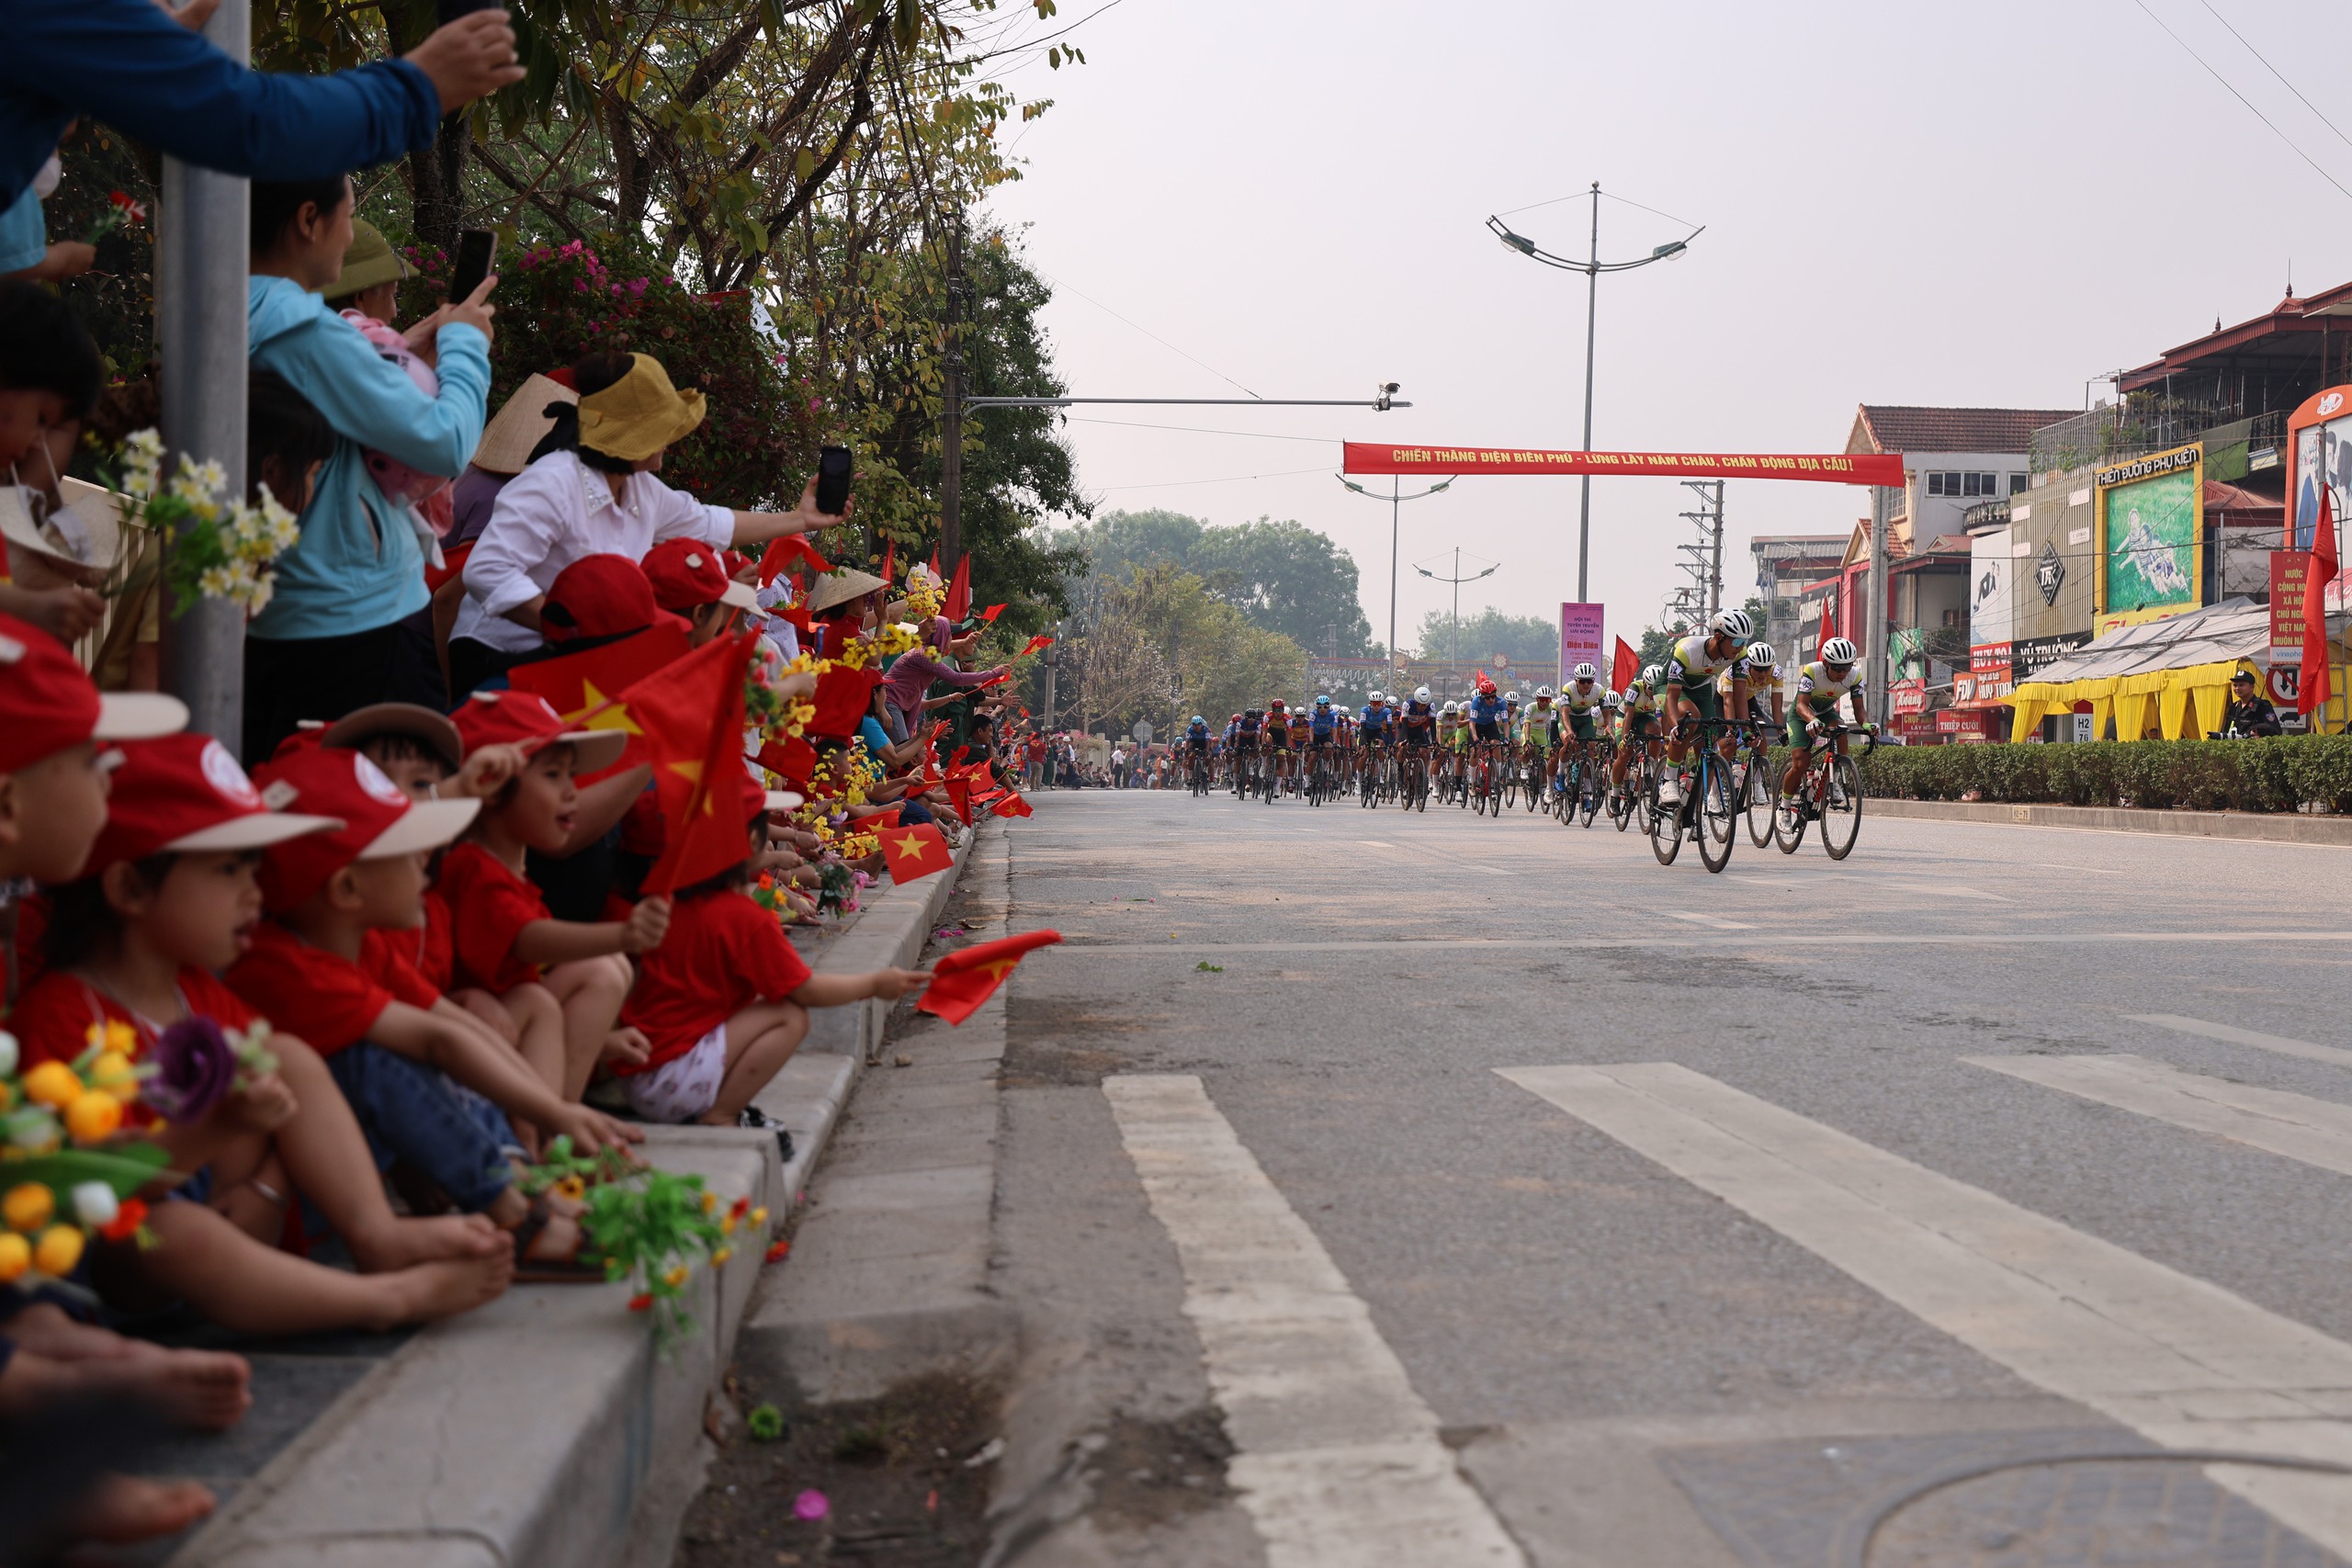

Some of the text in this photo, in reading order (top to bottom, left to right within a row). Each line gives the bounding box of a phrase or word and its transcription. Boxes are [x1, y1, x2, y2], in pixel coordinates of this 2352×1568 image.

[1393, 447, 1431, 462] CHIẾN
[1480, 450, 1511, 465] ĐIỆN
[1513, 452, 1544, 463] BIÊN
[1546, 452, 1573, 463] PHỦ
[1585, 453, 1619, 464] LỪNG
[1646, 455, 1679, 466] NĂM
[1681, 455, 1720, 468] CHÂU,
[1721, 456, 1758, 468] CHẤN
[1759, 457, 1796, 469] ĐỘNG
[1797, 457, 1820, 471] ĐỊA
[2097, 448, 2198, 485] THIÊN ĐƯỜNG PHỤ KIỆN
[2285, 569, 2303, 578] NƯỚC
[2278, 582, 2306, 593] CỘNG HO
[2283, 595, 2292, 605] XÃ
[1799, 591, 1835, 626] QUẢNG CO
[2276, 607, 2290, 619] CHỦ
[2278, 622, 2292, 634] VIỆT
[1567, 641, 1582, 650] Điện
[2273, 635, 2303, 646] MUÔN NĂ
[2020, 642, 2034, 664] VŨ
[2276, 649, 2302, 658] vinapho
[1939, 719, 1979, 732] THIỆP CƯỚI
[2077, 717, 2090, 729] H2
